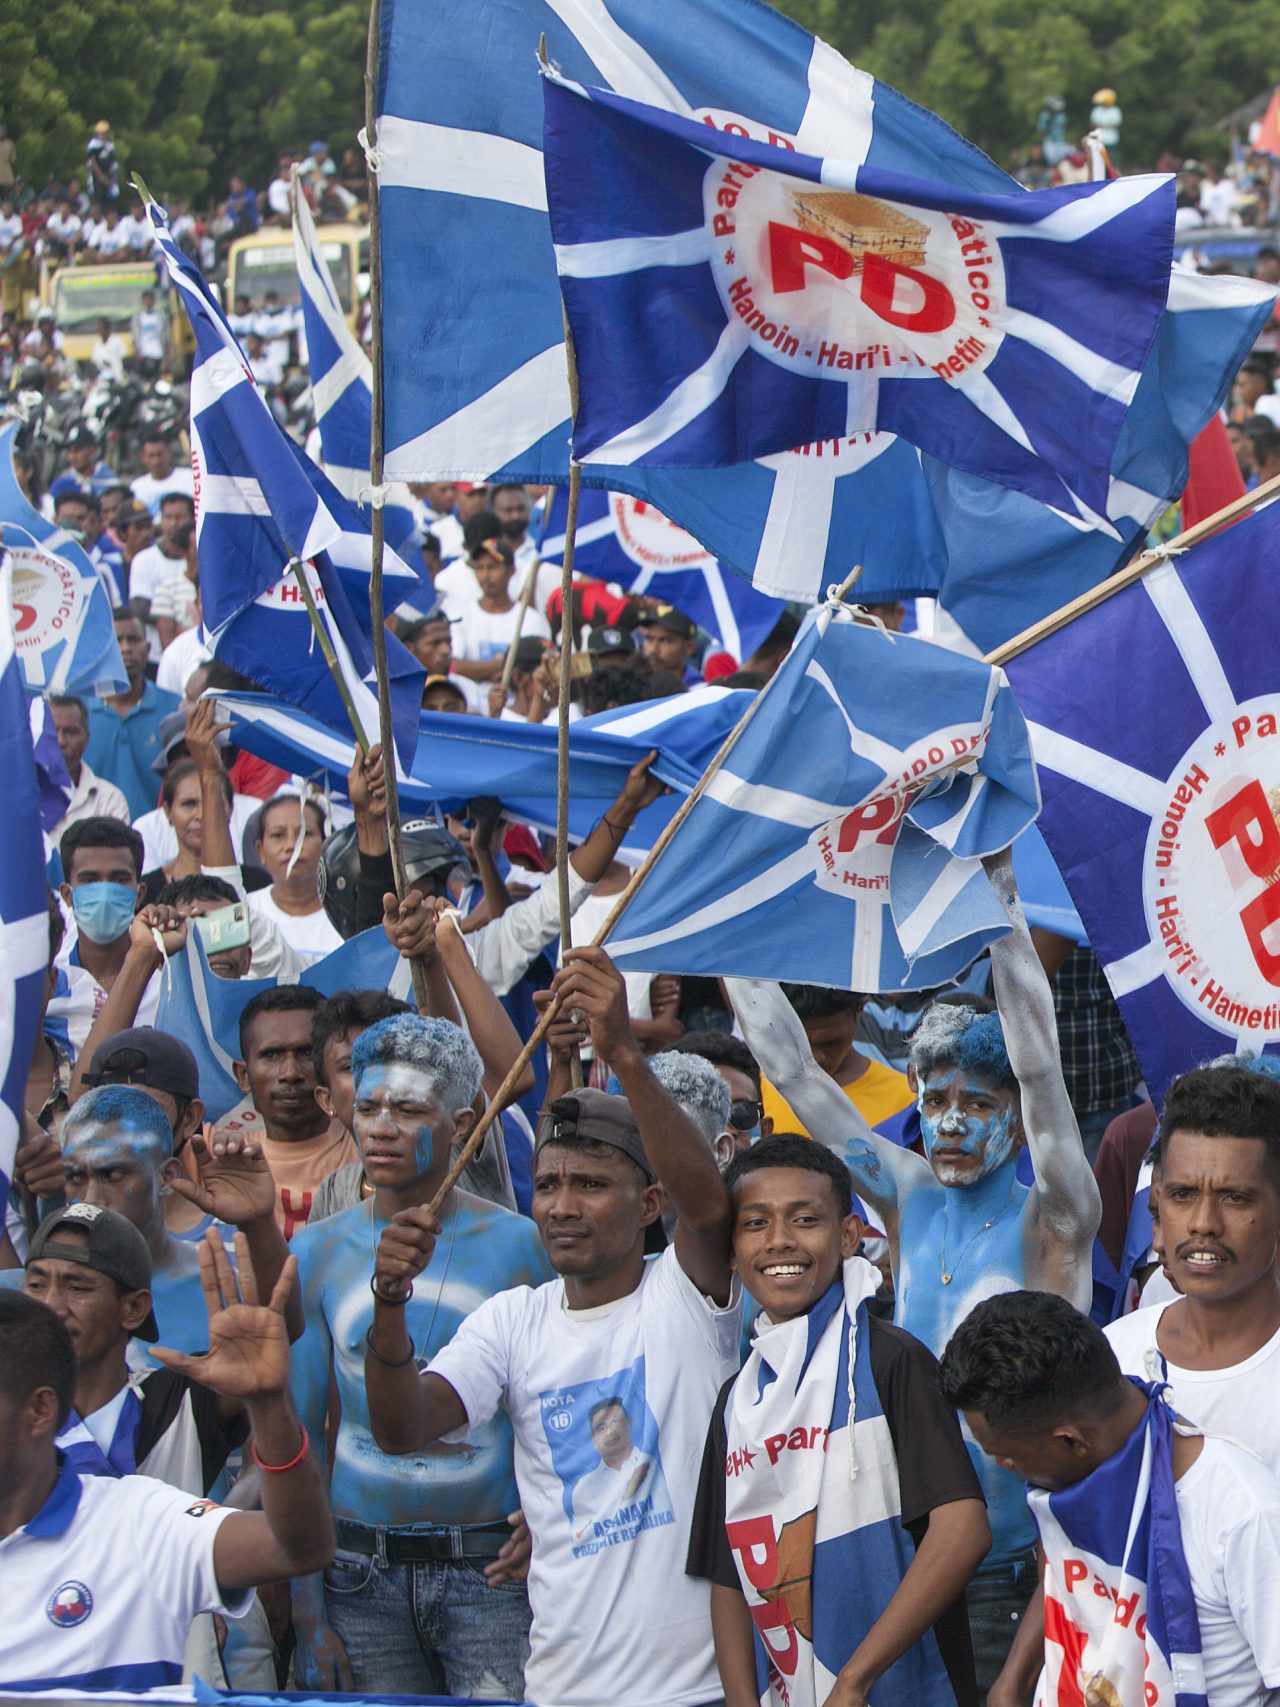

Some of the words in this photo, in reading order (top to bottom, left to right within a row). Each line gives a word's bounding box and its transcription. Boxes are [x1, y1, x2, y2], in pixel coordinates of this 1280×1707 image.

[728, 276, 800, 357] Hanoin
[768, 220, 956, 333] PD
[1154, 762, 1211, 869] Hanoin
[1155, 895, 1199, 976] Hari'i
[541, 1393, 576, 1409] VOTA
[551, 1412, 570, 1429] 16
[724, 1514, 800, 1676] PD
